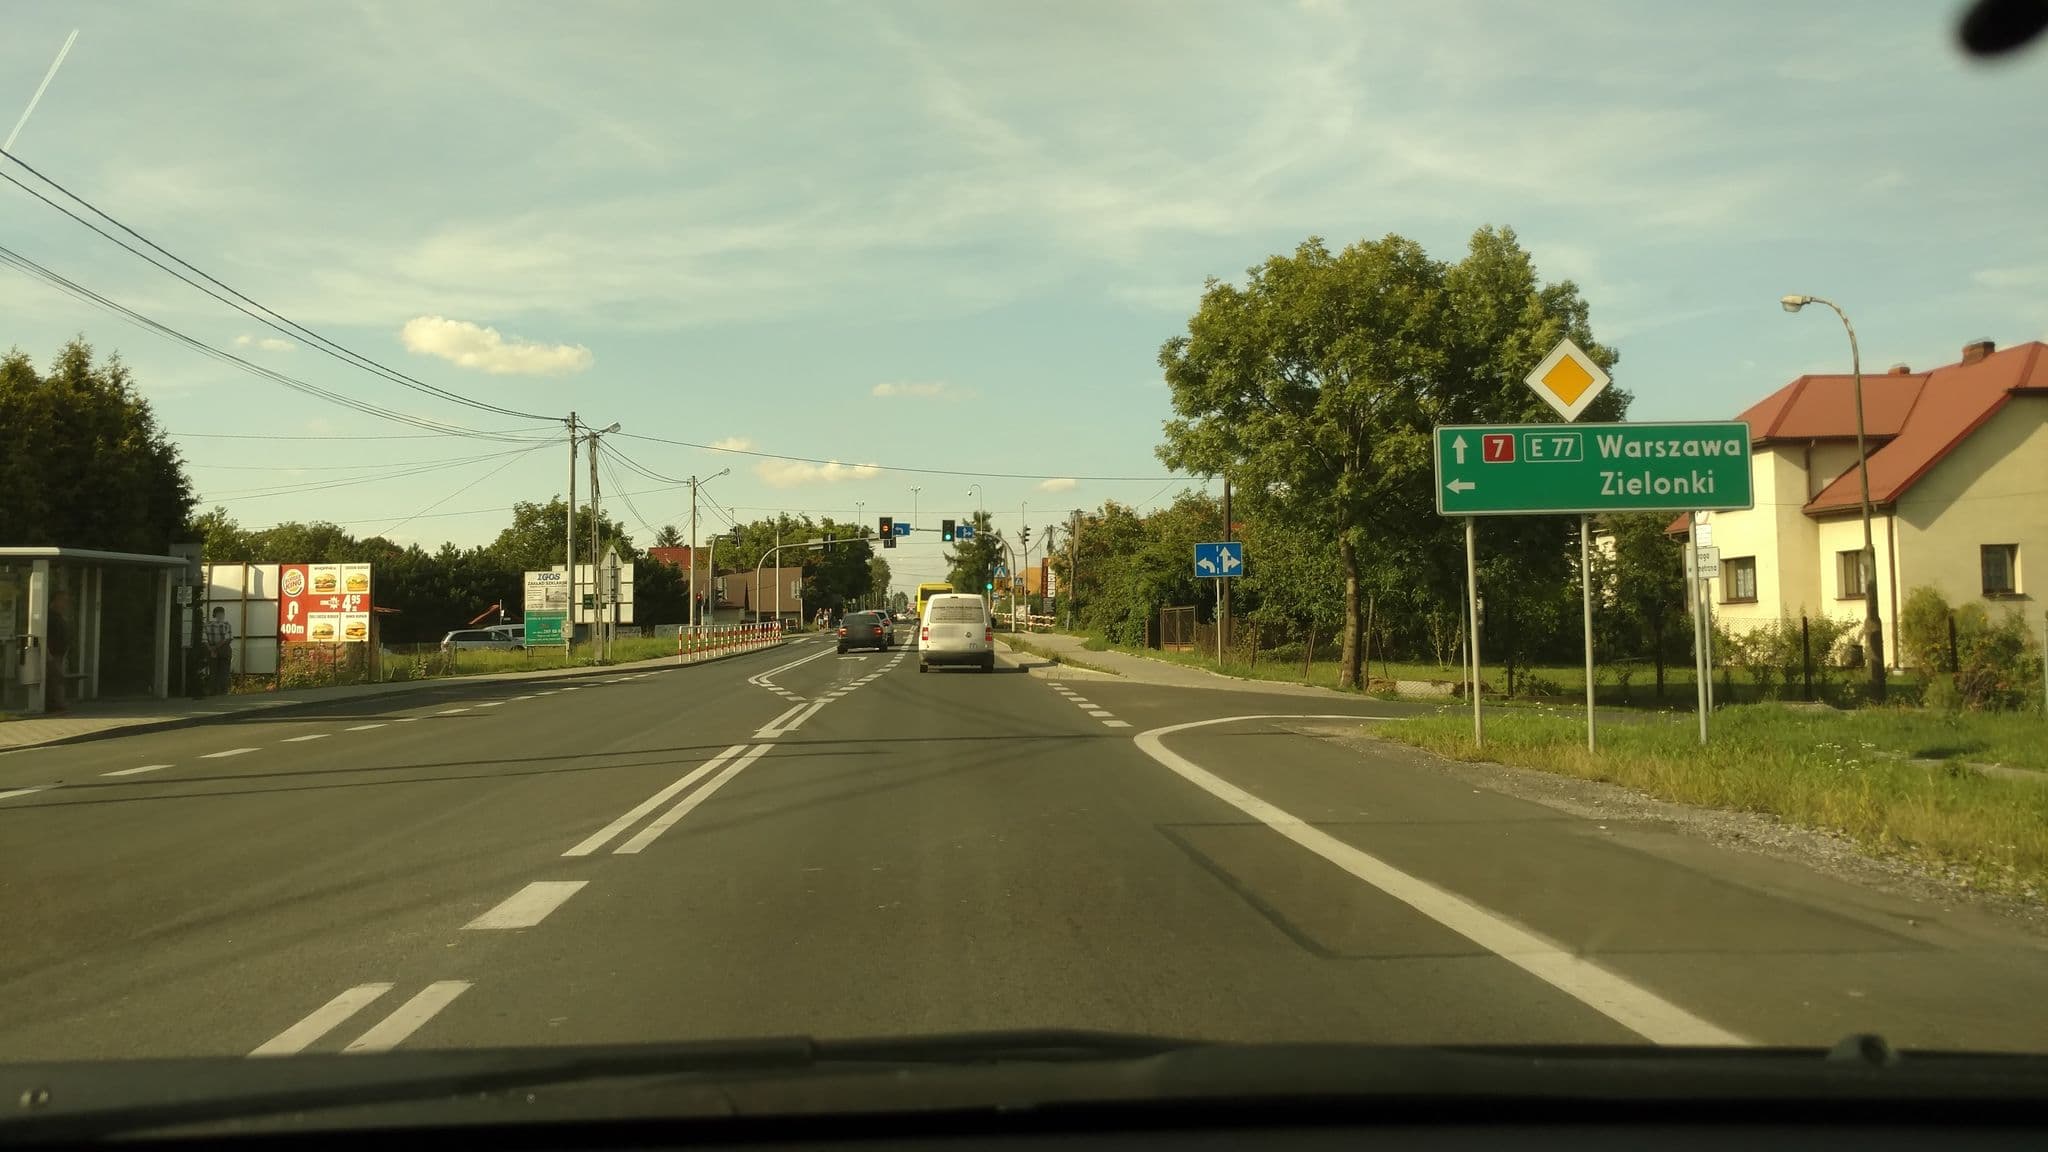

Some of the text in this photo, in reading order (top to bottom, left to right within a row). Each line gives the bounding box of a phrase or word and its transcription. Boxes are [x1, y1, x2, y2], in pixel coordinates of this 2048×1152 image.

[1492, 439, 1505, 458] 7
[1531, 438, 1574, 457] E 77
[1596, 434, 1741, 458] Warszawa
[1599, 469, 1715, 495] Zielonki
[280, 623, 305, 634] 400m
